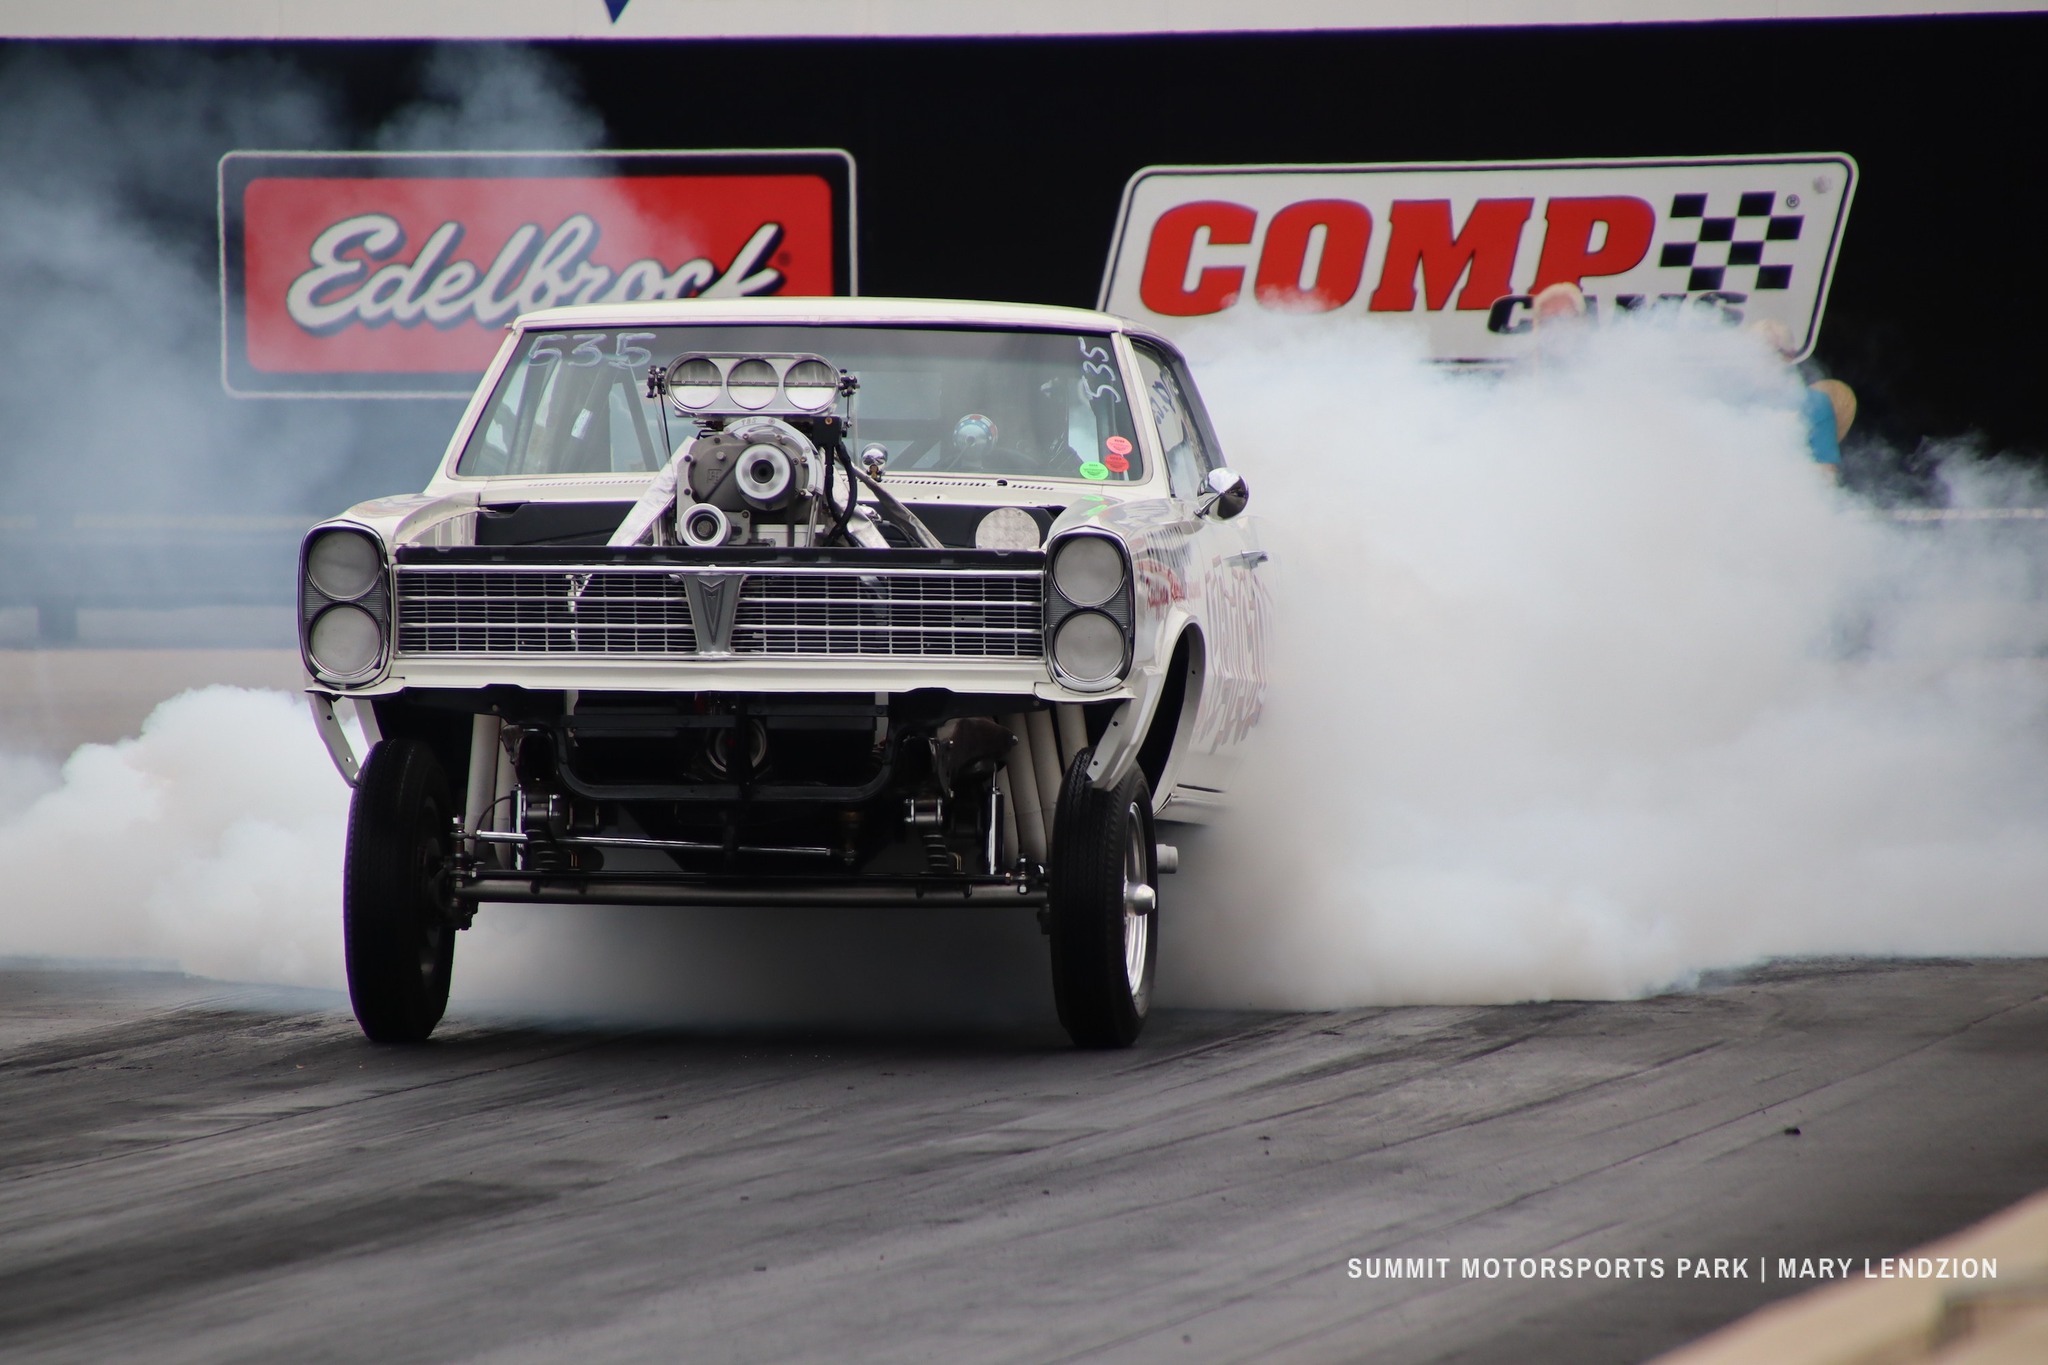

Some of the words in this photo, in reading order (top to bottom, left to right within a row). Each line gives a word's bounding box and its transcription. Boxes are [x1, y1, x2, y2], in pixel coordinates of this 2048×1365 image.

[286, 213, 785, 336] Edelbrock
[1139, 195, 1656, 316] COMP
[1487, 290, 1749, 335] CS
[527, 331, 657, 369] 535
[1077, 336, 1122, 403] 535
